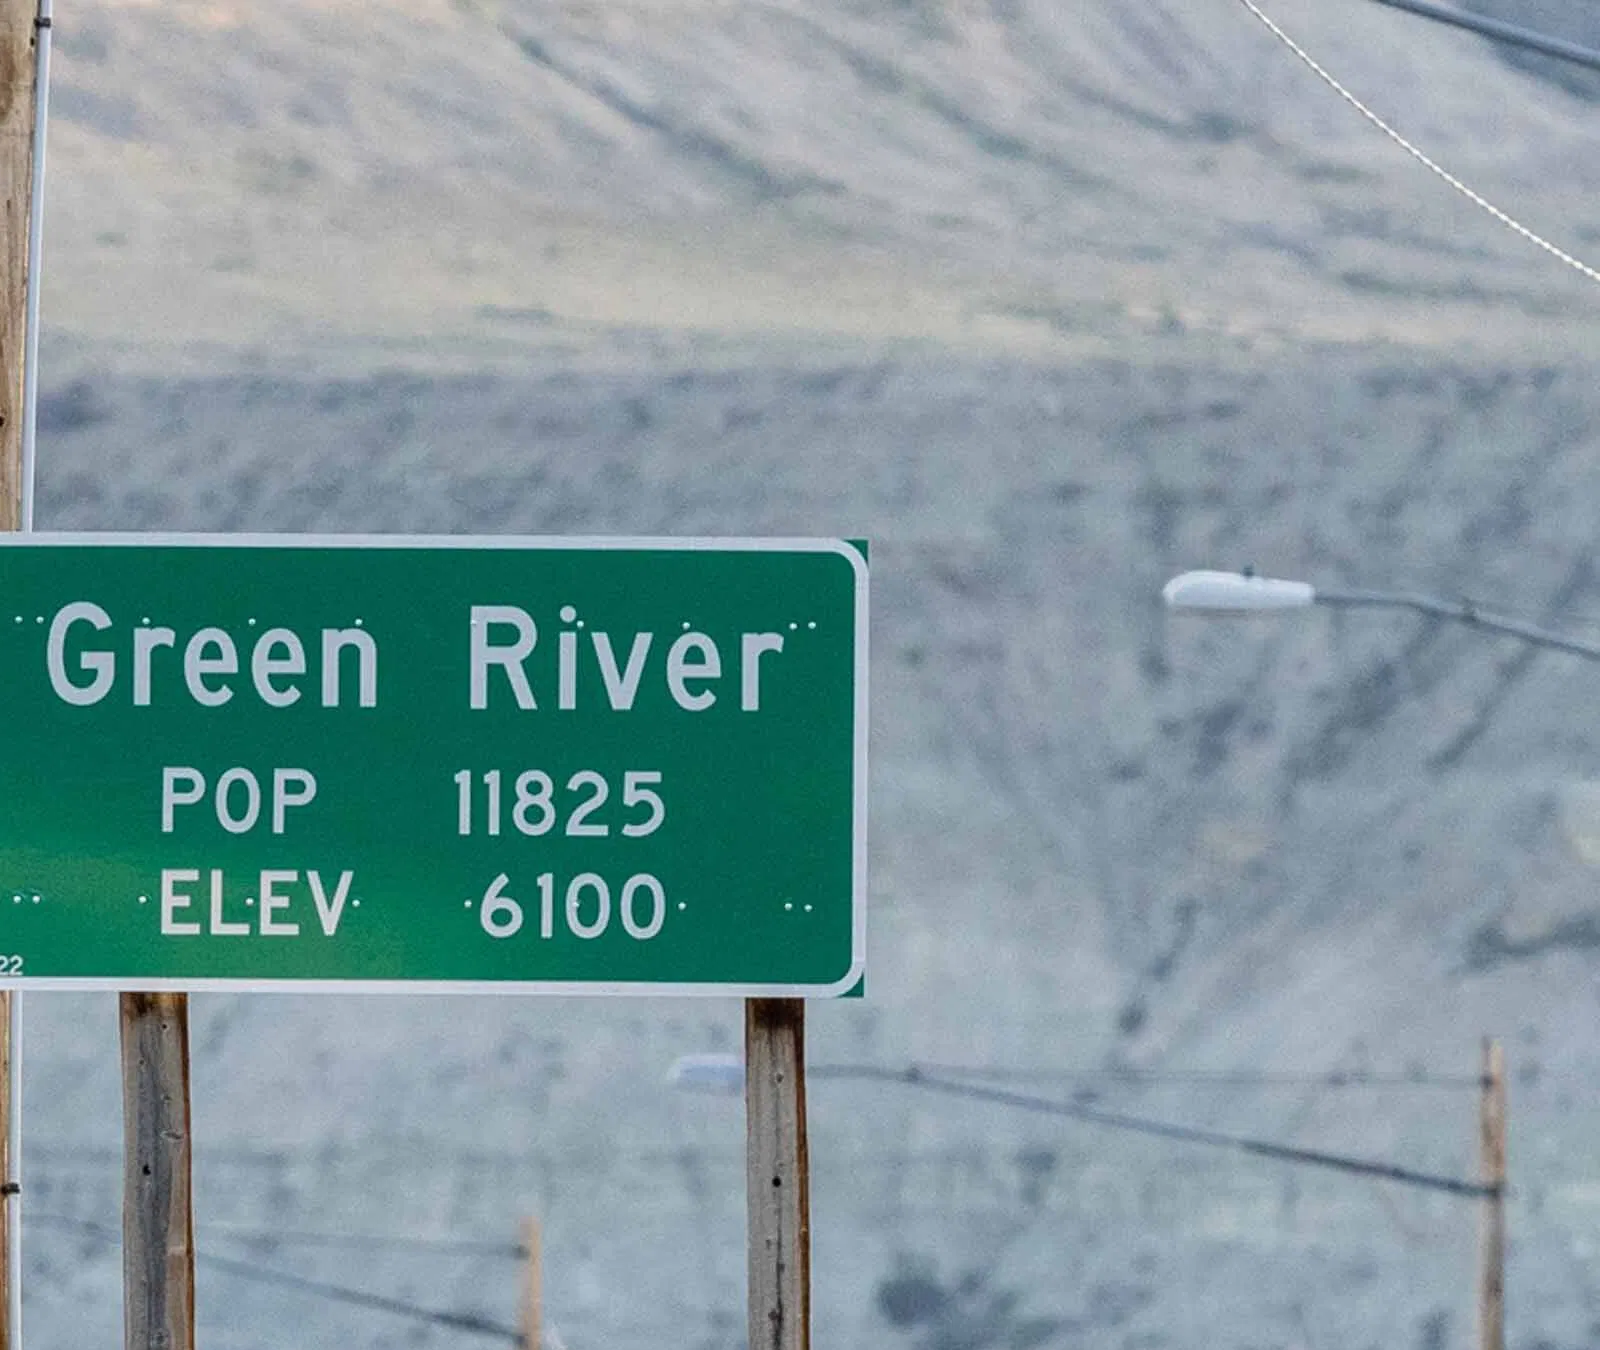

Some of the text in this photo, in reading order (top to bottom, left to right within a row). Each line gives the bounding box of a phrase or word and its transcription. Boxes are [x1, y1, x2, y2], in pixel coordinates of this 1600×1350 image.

[47, 602, 785, 711] Green River
[162, 767, 665, 837] POP 11825
[161, 869, 665, 940] ELEV 6100
